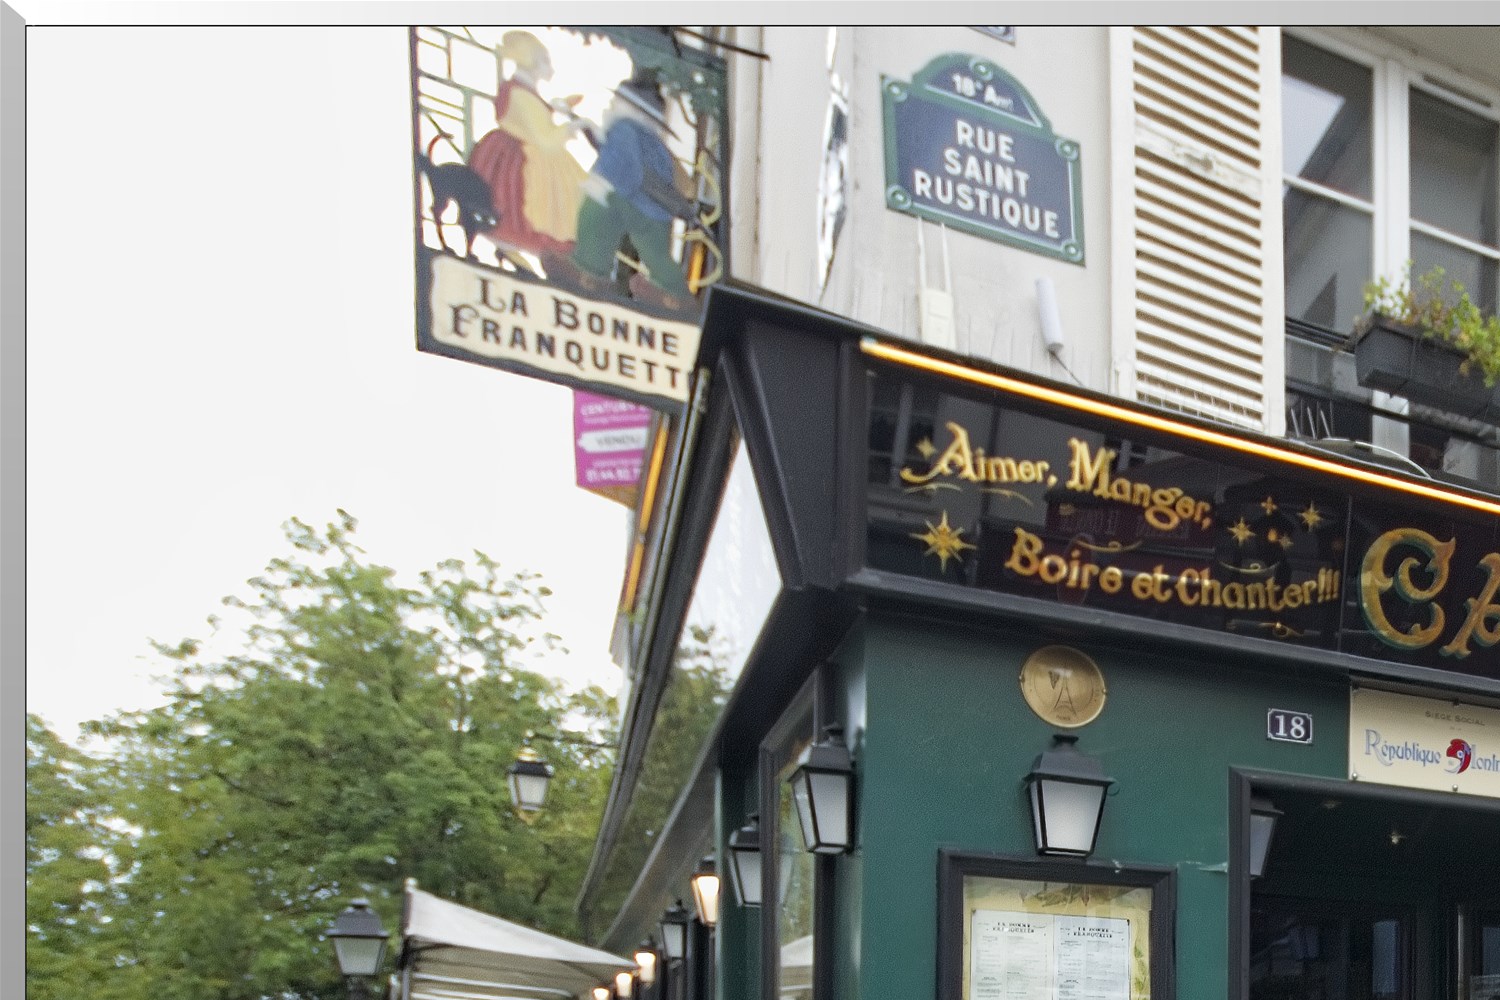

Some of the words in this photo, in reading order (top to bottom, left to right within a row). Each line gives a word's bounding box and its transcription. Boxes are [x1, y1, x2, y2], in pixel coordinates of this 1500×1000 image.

[957, 119, 1016, 163] RUE
[944, 148, 1030, 198] SAINT
[913, 169, 1060, 239] RUSTIQUE
[449, 302, 681, 389] FRANQUETT
[477, 276, 529, 318] LA
[552, 295, 680, 357] BONNE
[900, 422, 1059, 487] Aimer,
[1066, 437, 1214, 531] Manger,
[1004, 526, 1123, 596] Boire
[1131, 560, 1173, 602] et
[1174, 566, 1343, 613] Chanter!!!
[1275, 713, 1305, 740] 18
[1365, 728, 1442, 767] République
[1454, 714, 1486, 726] SOCIAL
